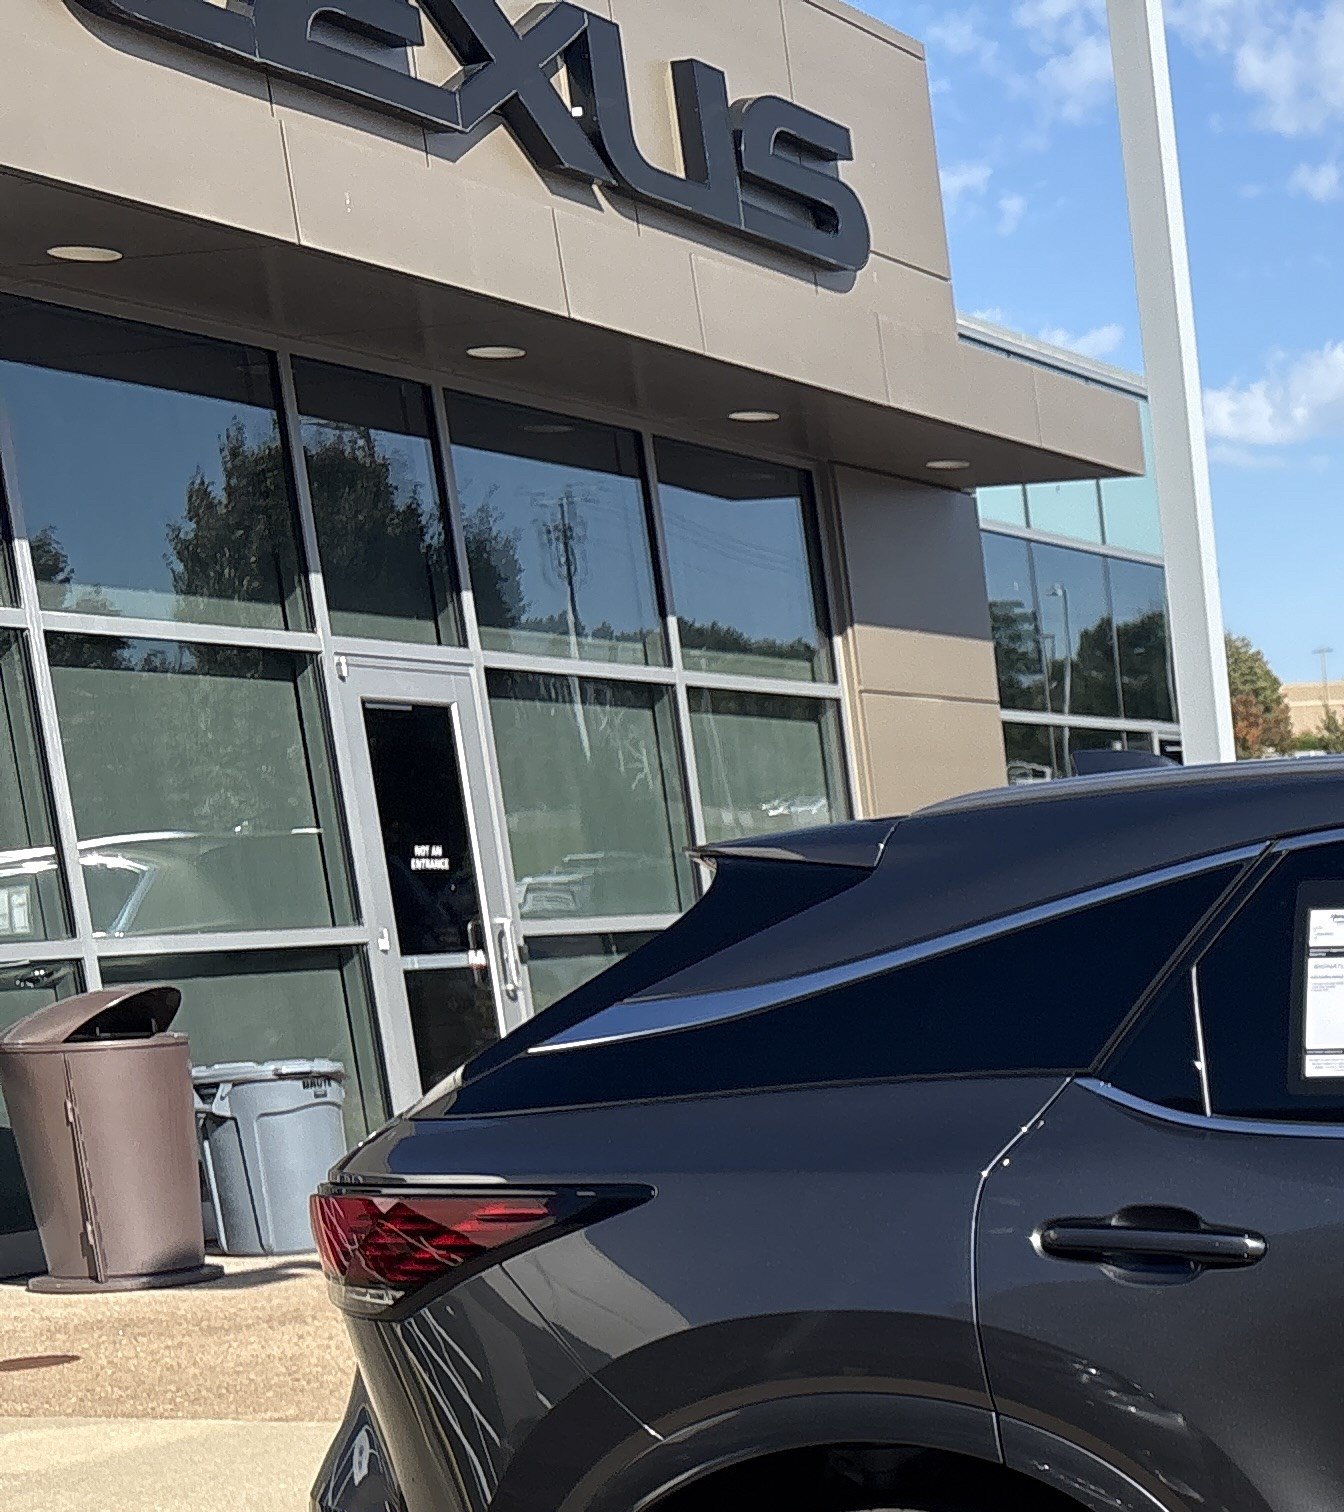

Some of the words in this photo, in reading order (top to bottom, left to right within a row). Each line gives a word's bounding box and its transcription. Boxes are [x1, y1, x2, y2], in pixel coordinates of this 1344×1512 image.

[414, 845, 430, 857] NOT
[431, 845, 443, 857] AN
[411, 858, 450, 870] ENTRANCE
